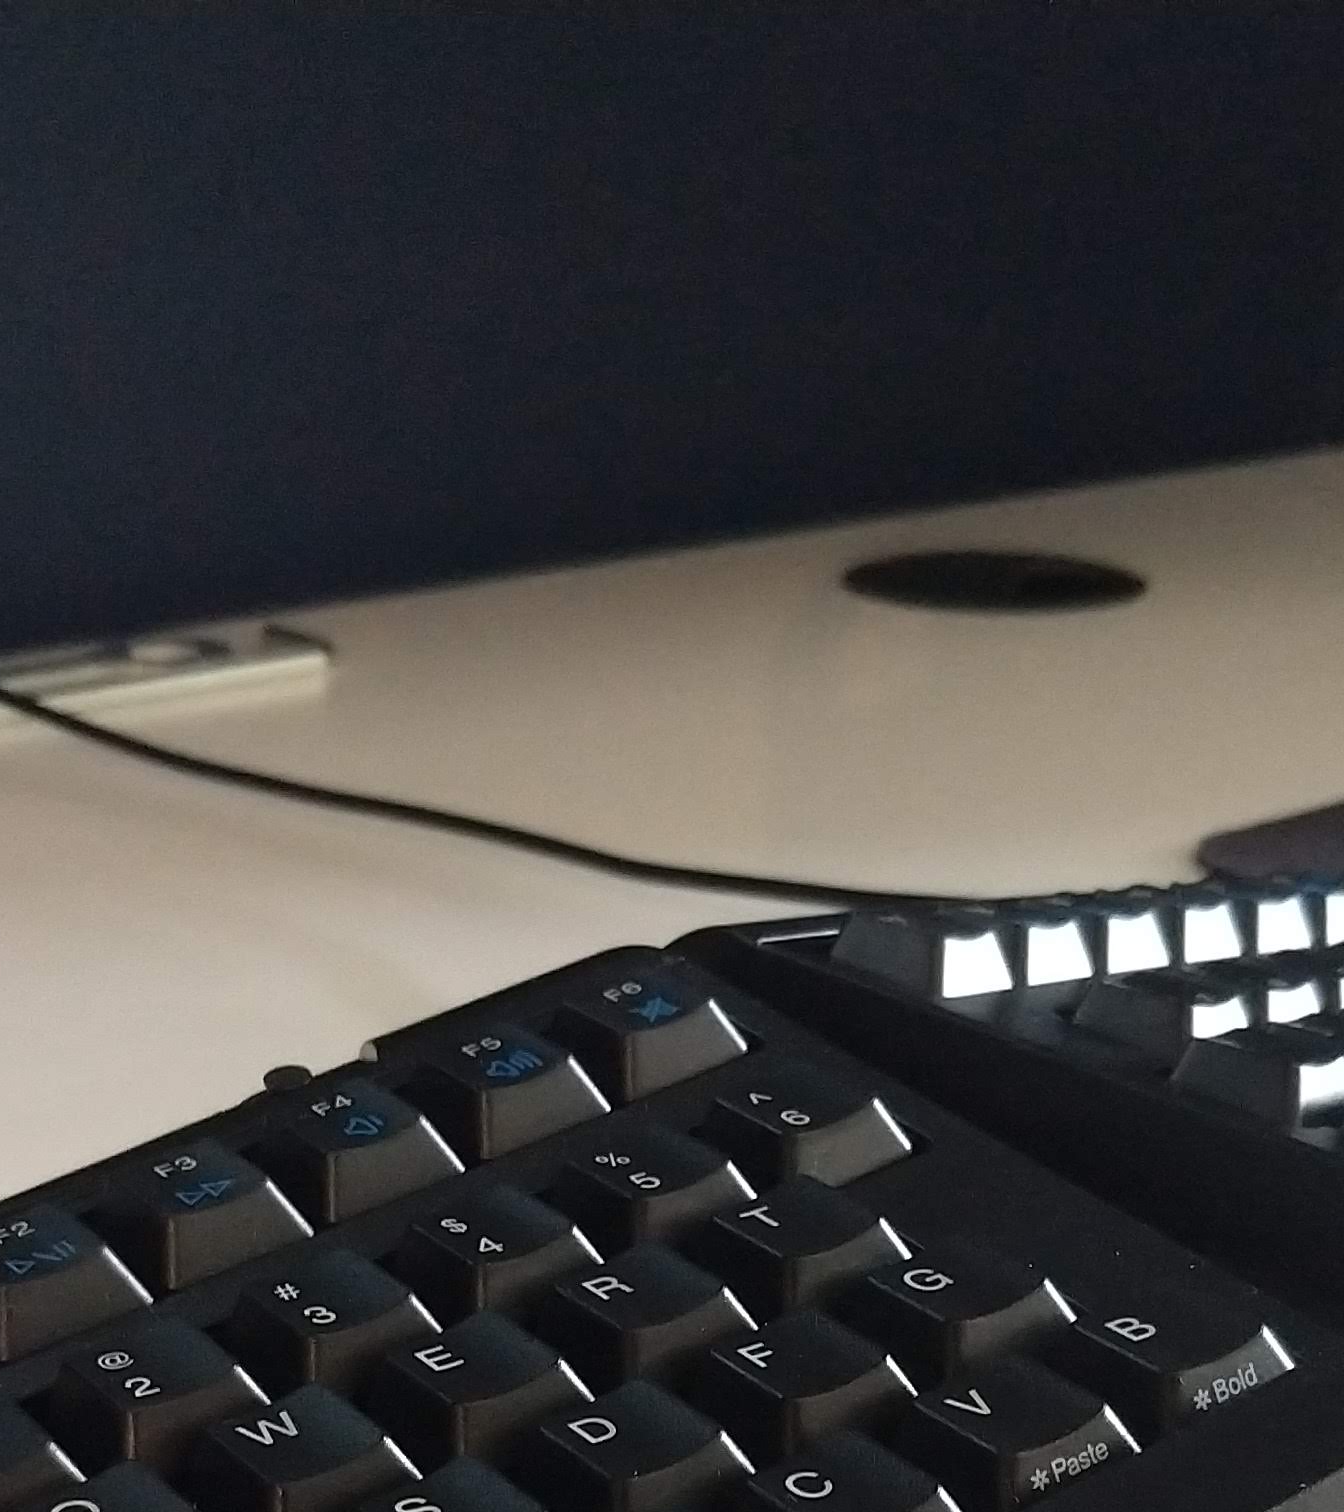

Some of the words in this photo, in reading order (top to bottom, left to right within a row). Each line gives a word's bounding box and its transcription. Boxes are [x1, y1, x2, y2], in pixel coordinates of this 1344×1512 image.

[603, 982, 643, 1003] F6
[461, 1036, 503, 1058] F5
[310, 1095, 354, 1117] F4
[779, 1109, 811, 1127] 6
[153, 1155, 198, 1180] F3
[594, 1151, 631, 1168] %
[628, 1171, 662, 1190] 5
[438, 1217, 468, 1235] $
[738, 1205, 782, 1229] T
[477, 1236, 505, 1254] 4
[272, 1282, 301, 1302] #
[580, 1275, 636, 1301] R
[902, 1267, 954, 1293] G
[303, 1305, 338, 1326] 3
[1104, 1317, 1156, 1343] B
[96, 1350, 136, 1372] @
[413, 1344, 465, 1374] E
[737, 1342, 775, 1368] F
[124, 1375, 161, 1399] 2
[942, 1388, 993, 1418] V
[234, 1409, 300, 1447] W
[568, 1415, 618, 1445] D
[784, 1470, 834, 1500] C
